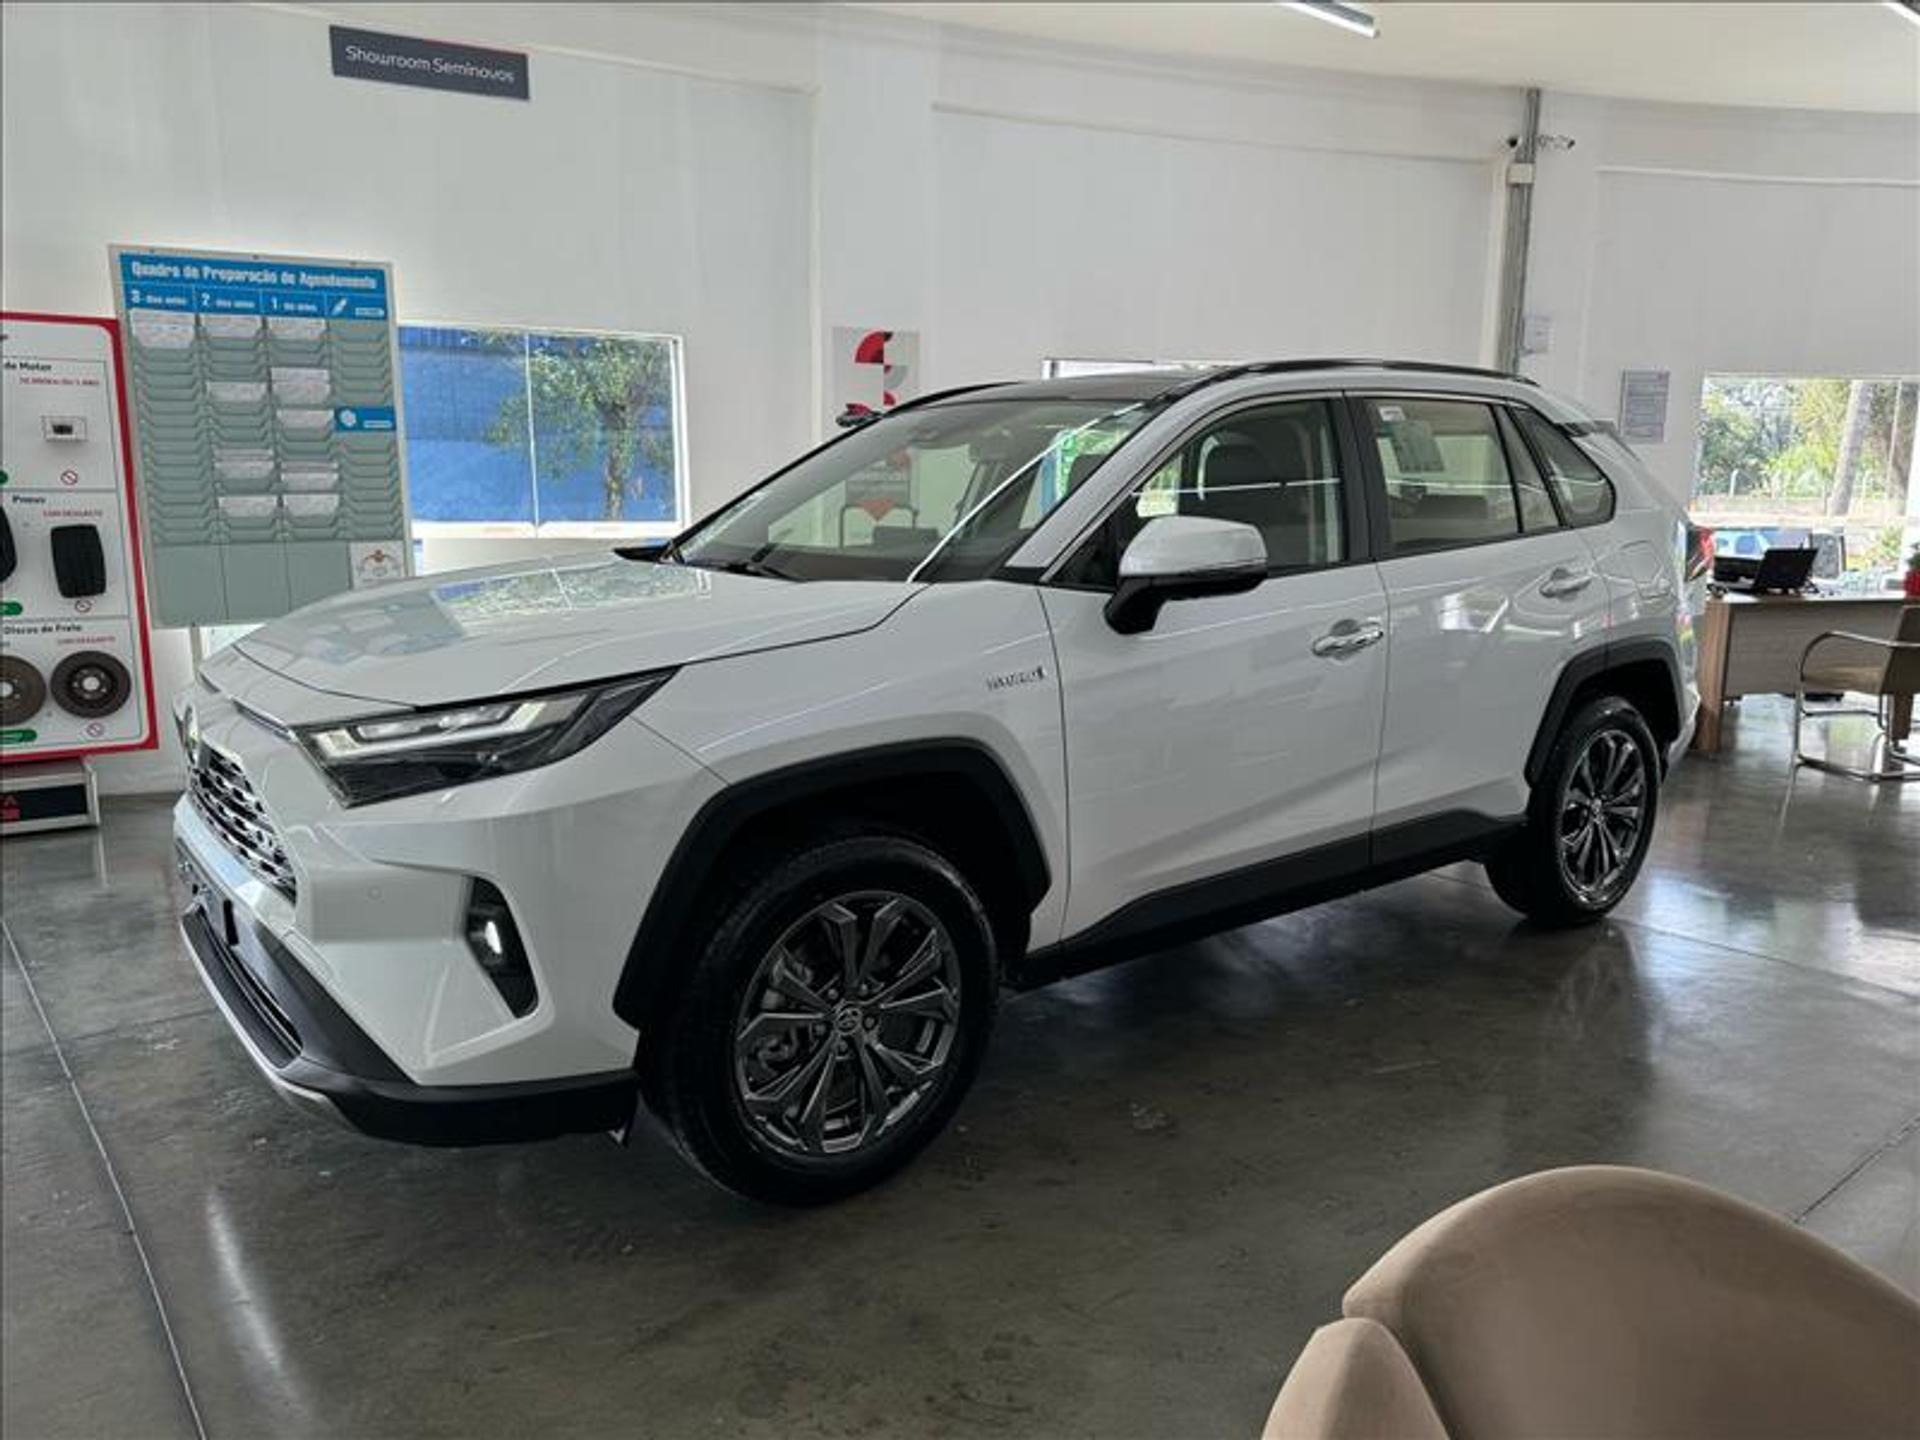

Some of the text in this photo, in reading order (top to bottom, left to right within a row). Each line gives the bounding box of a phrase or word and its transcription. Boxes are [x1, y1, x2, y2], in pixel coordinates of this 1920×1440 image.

[345, 45, 515, 84] Showroom Seminovos
[131, 261, 180, 278] Quadro
[201, 292, 211, 307] 2
[271, 296, 278, 311] 1
[4, 626, 39, 634] Discos
[55, 624, 82, 632] Freio
